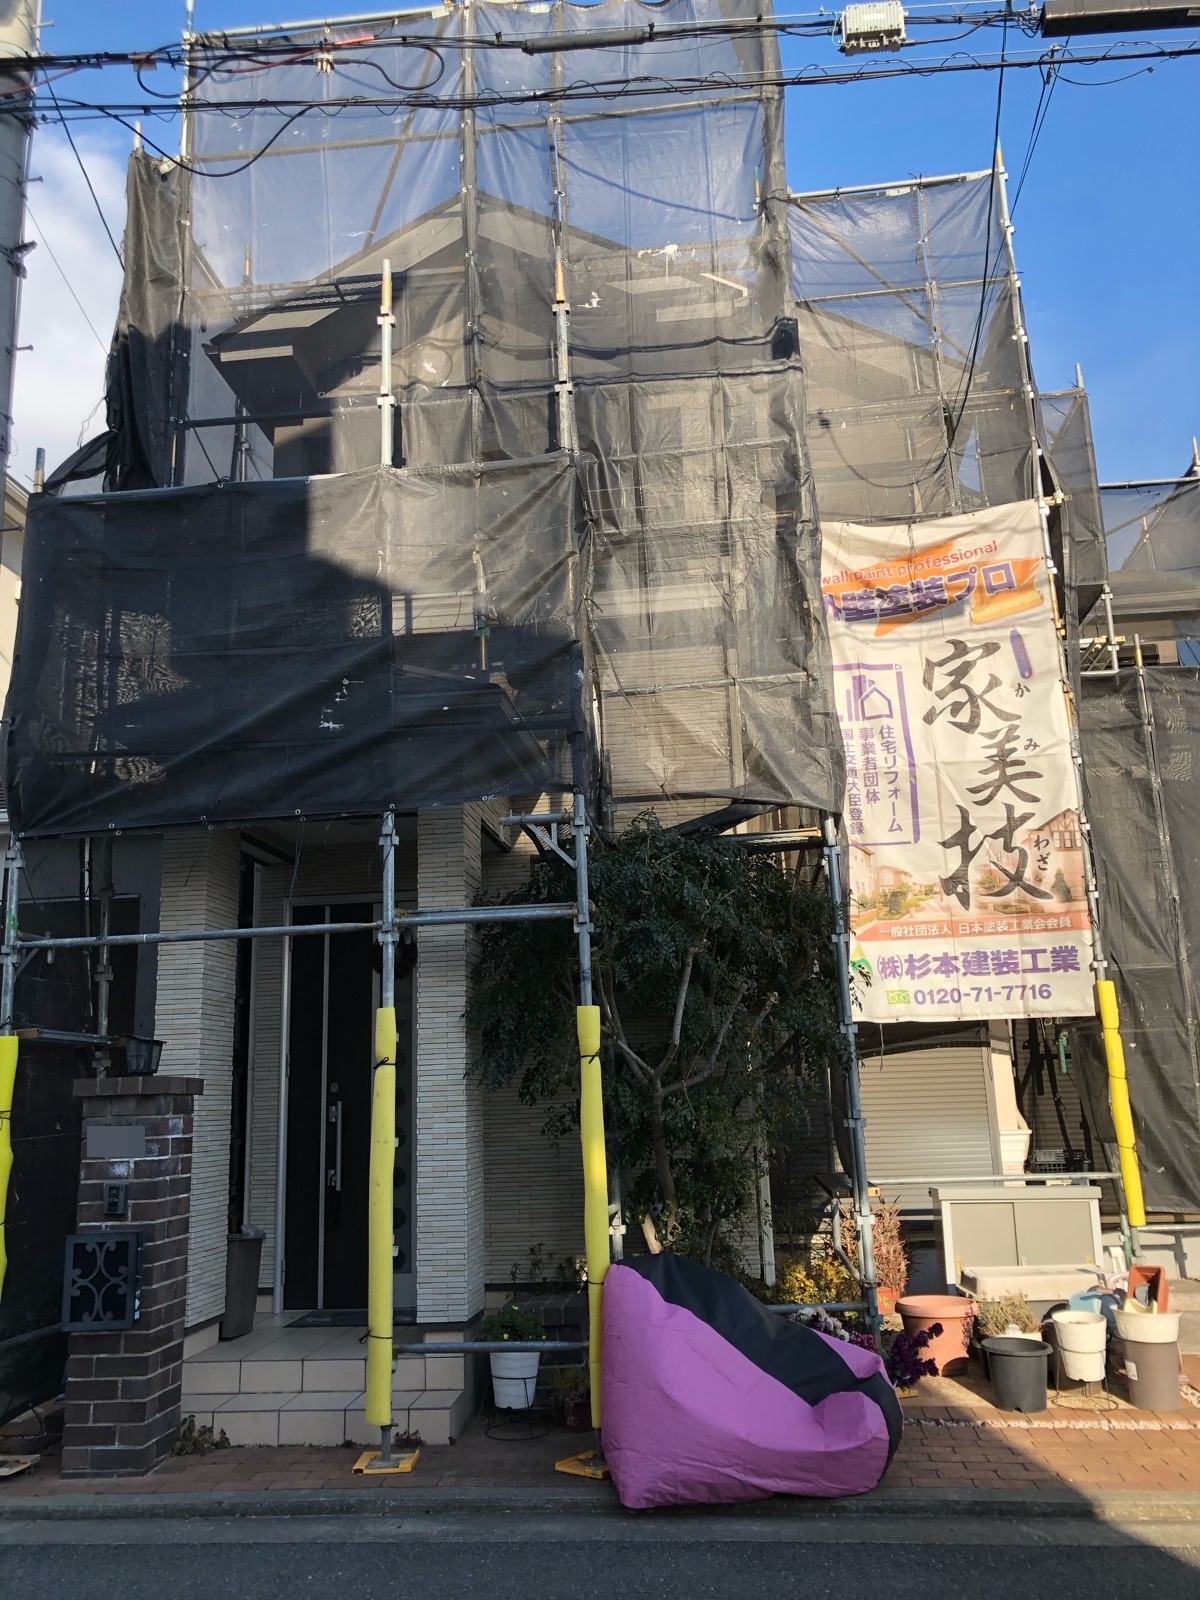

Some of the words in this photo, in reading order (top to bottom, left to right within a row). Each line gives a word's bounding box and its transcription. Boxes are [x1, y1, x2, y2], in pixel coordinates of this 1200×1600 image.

[821, 570, 849, 585] wall
[854, 566, 893, 582] paint
[897, 540, 998, 577] professional
[842, 728, 865, 836] 国土交通大臣登録
[858, 727, 881, 804] 事業者団体
[879, 724, 904, 833] 住宅リフォーム
[922, 638, 1054, 911] 家美技
[1014, 682, 1031, 698] か
[1023, 738, 1041, 751] み
[1033, 834, 1051, 871] わざ
[879, 924, 952, 938] 一般社団法人
[958, 916, 1072, 935] 日本塗装工業会会員
[913, 983, 1053, 1006] 0120-71-7716
